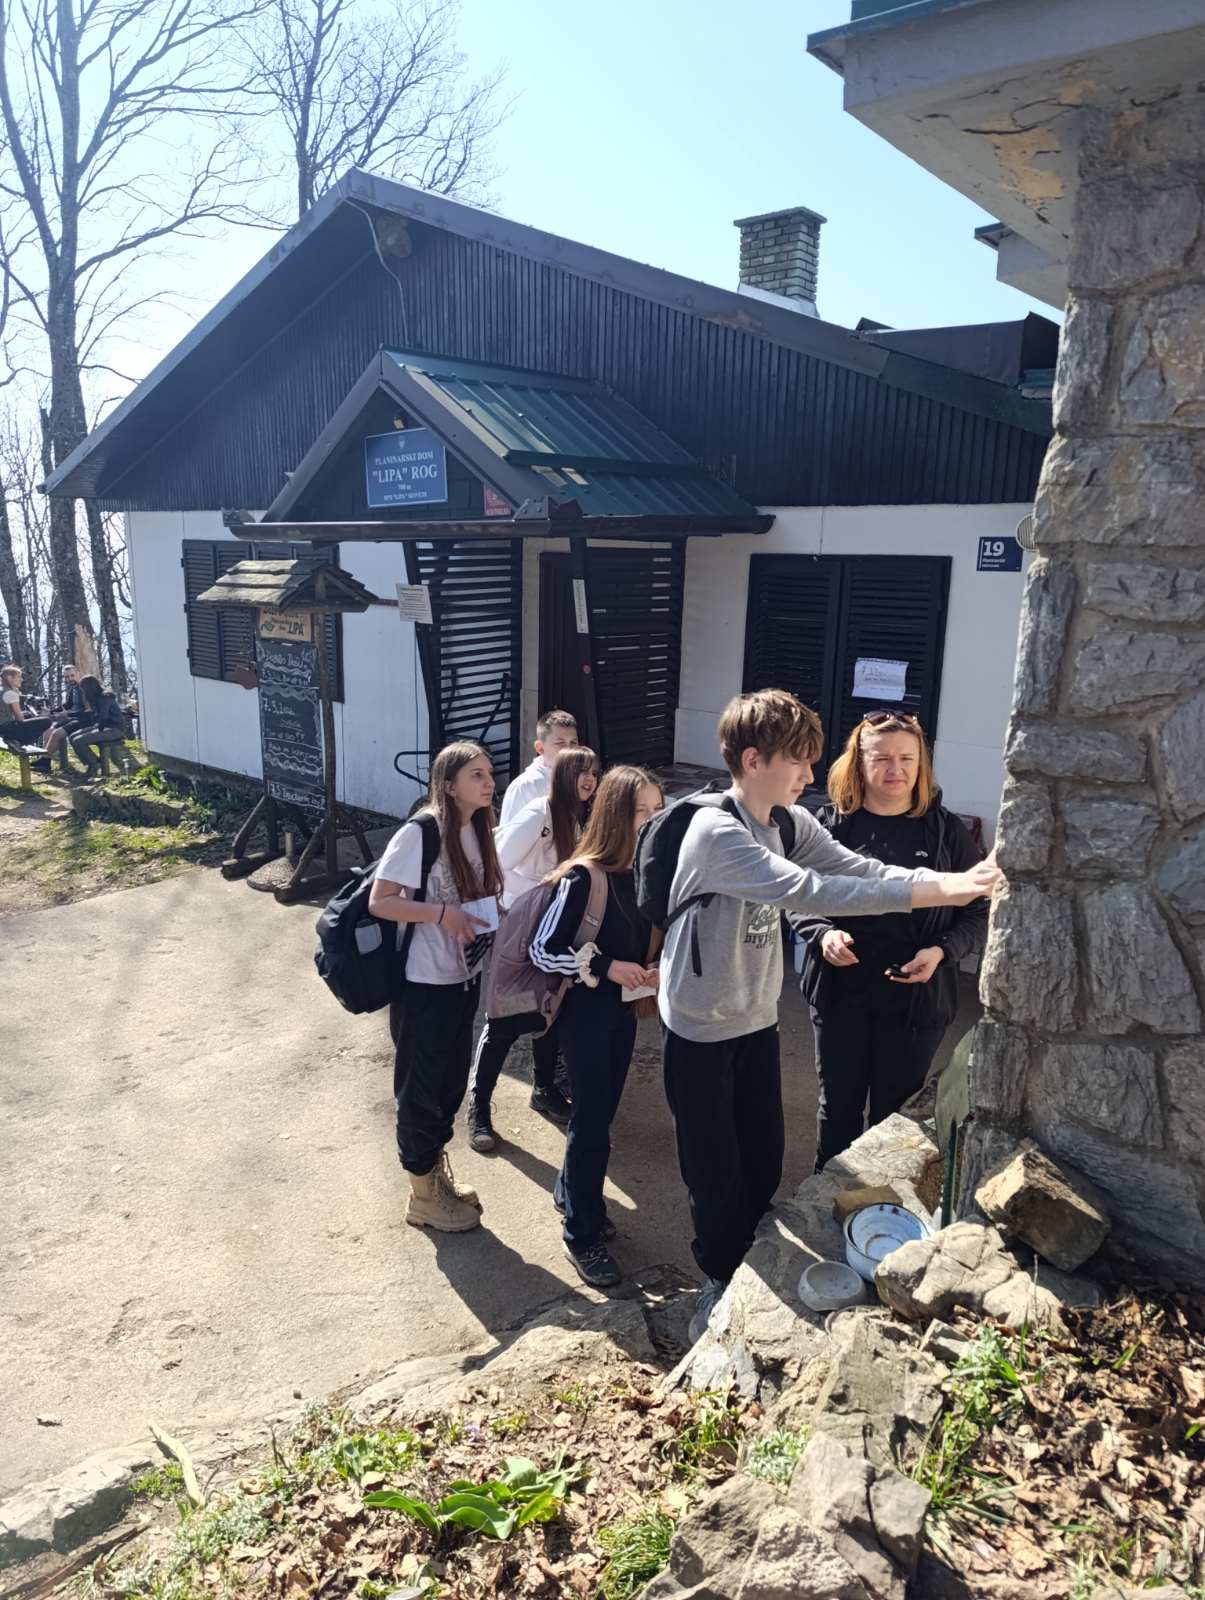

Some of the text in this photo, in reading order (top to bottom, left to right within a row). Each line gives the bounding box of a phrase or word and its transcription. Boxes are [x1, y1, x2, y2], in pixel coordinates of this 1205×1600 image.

[375, 453, 416, 465] PLANINARSKI
[372, 464, 438, 483] "LIPA" ROG
[983, 541, 1005, 556] 19
[287, 621, 305, 636] LIPA
